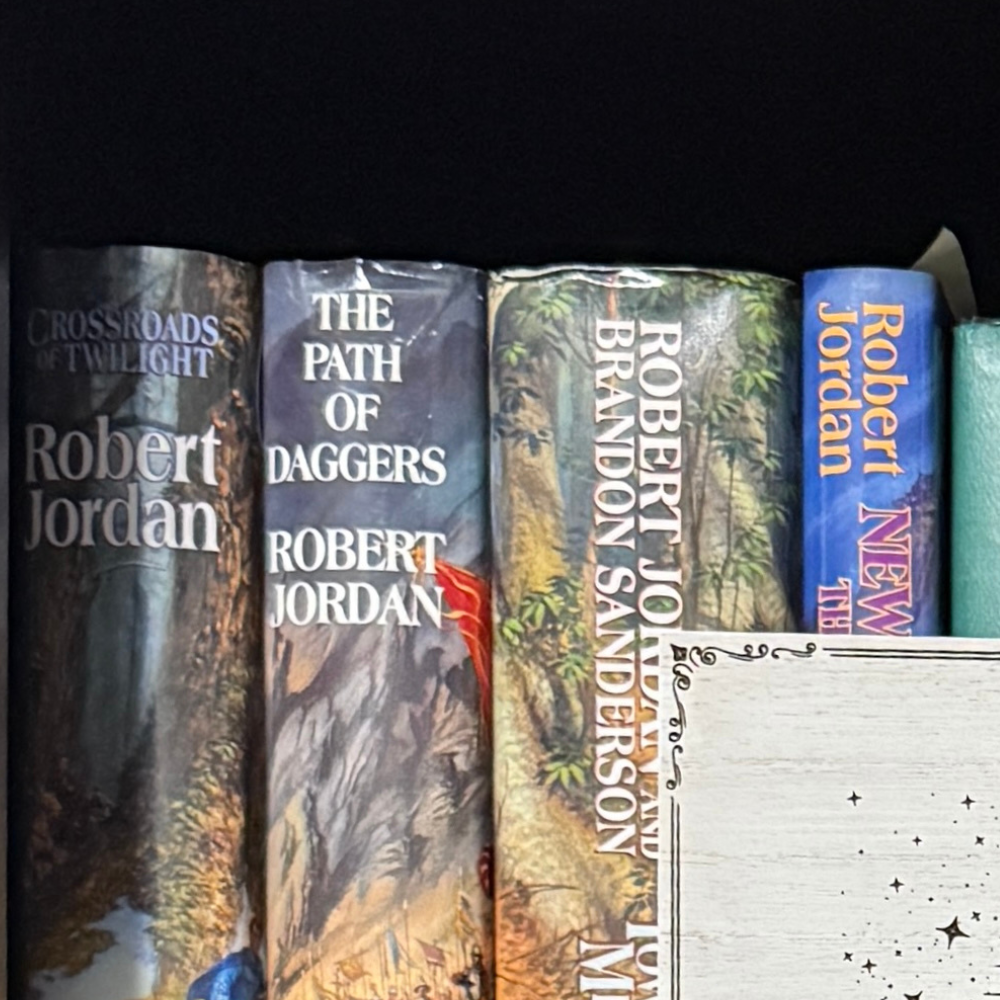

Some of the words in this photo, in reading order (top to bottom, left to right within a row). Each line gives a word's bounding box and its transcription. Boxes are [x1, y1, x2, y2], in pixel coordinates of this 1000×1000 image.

[27, 308, 219, 347] CROSSROADS
[312, 292, 394, 332] THE
[66, 342, 214, 379] TWILIGHT
[303, 342, 402, 383] PATH
[818, 301, 862, 477] Jordan
[861, 301, 909, 477] Robert
[325, 392, 381, 433] OF
[594, 318, 636, 551] BRANDON
[638, 320, 682, 545] ROBERT
[24, 416, 221, 486] Robert
[268, 442, 447, 485] DAGGERS
[23, 484, 220, 553] Jordan
[268, 528, 447, 574] ROBERT
[857, 502, 914, 636] NEW
[269, 580, 446, 629] JORDAN
[594, 565, 636, 856] SANDERSON
